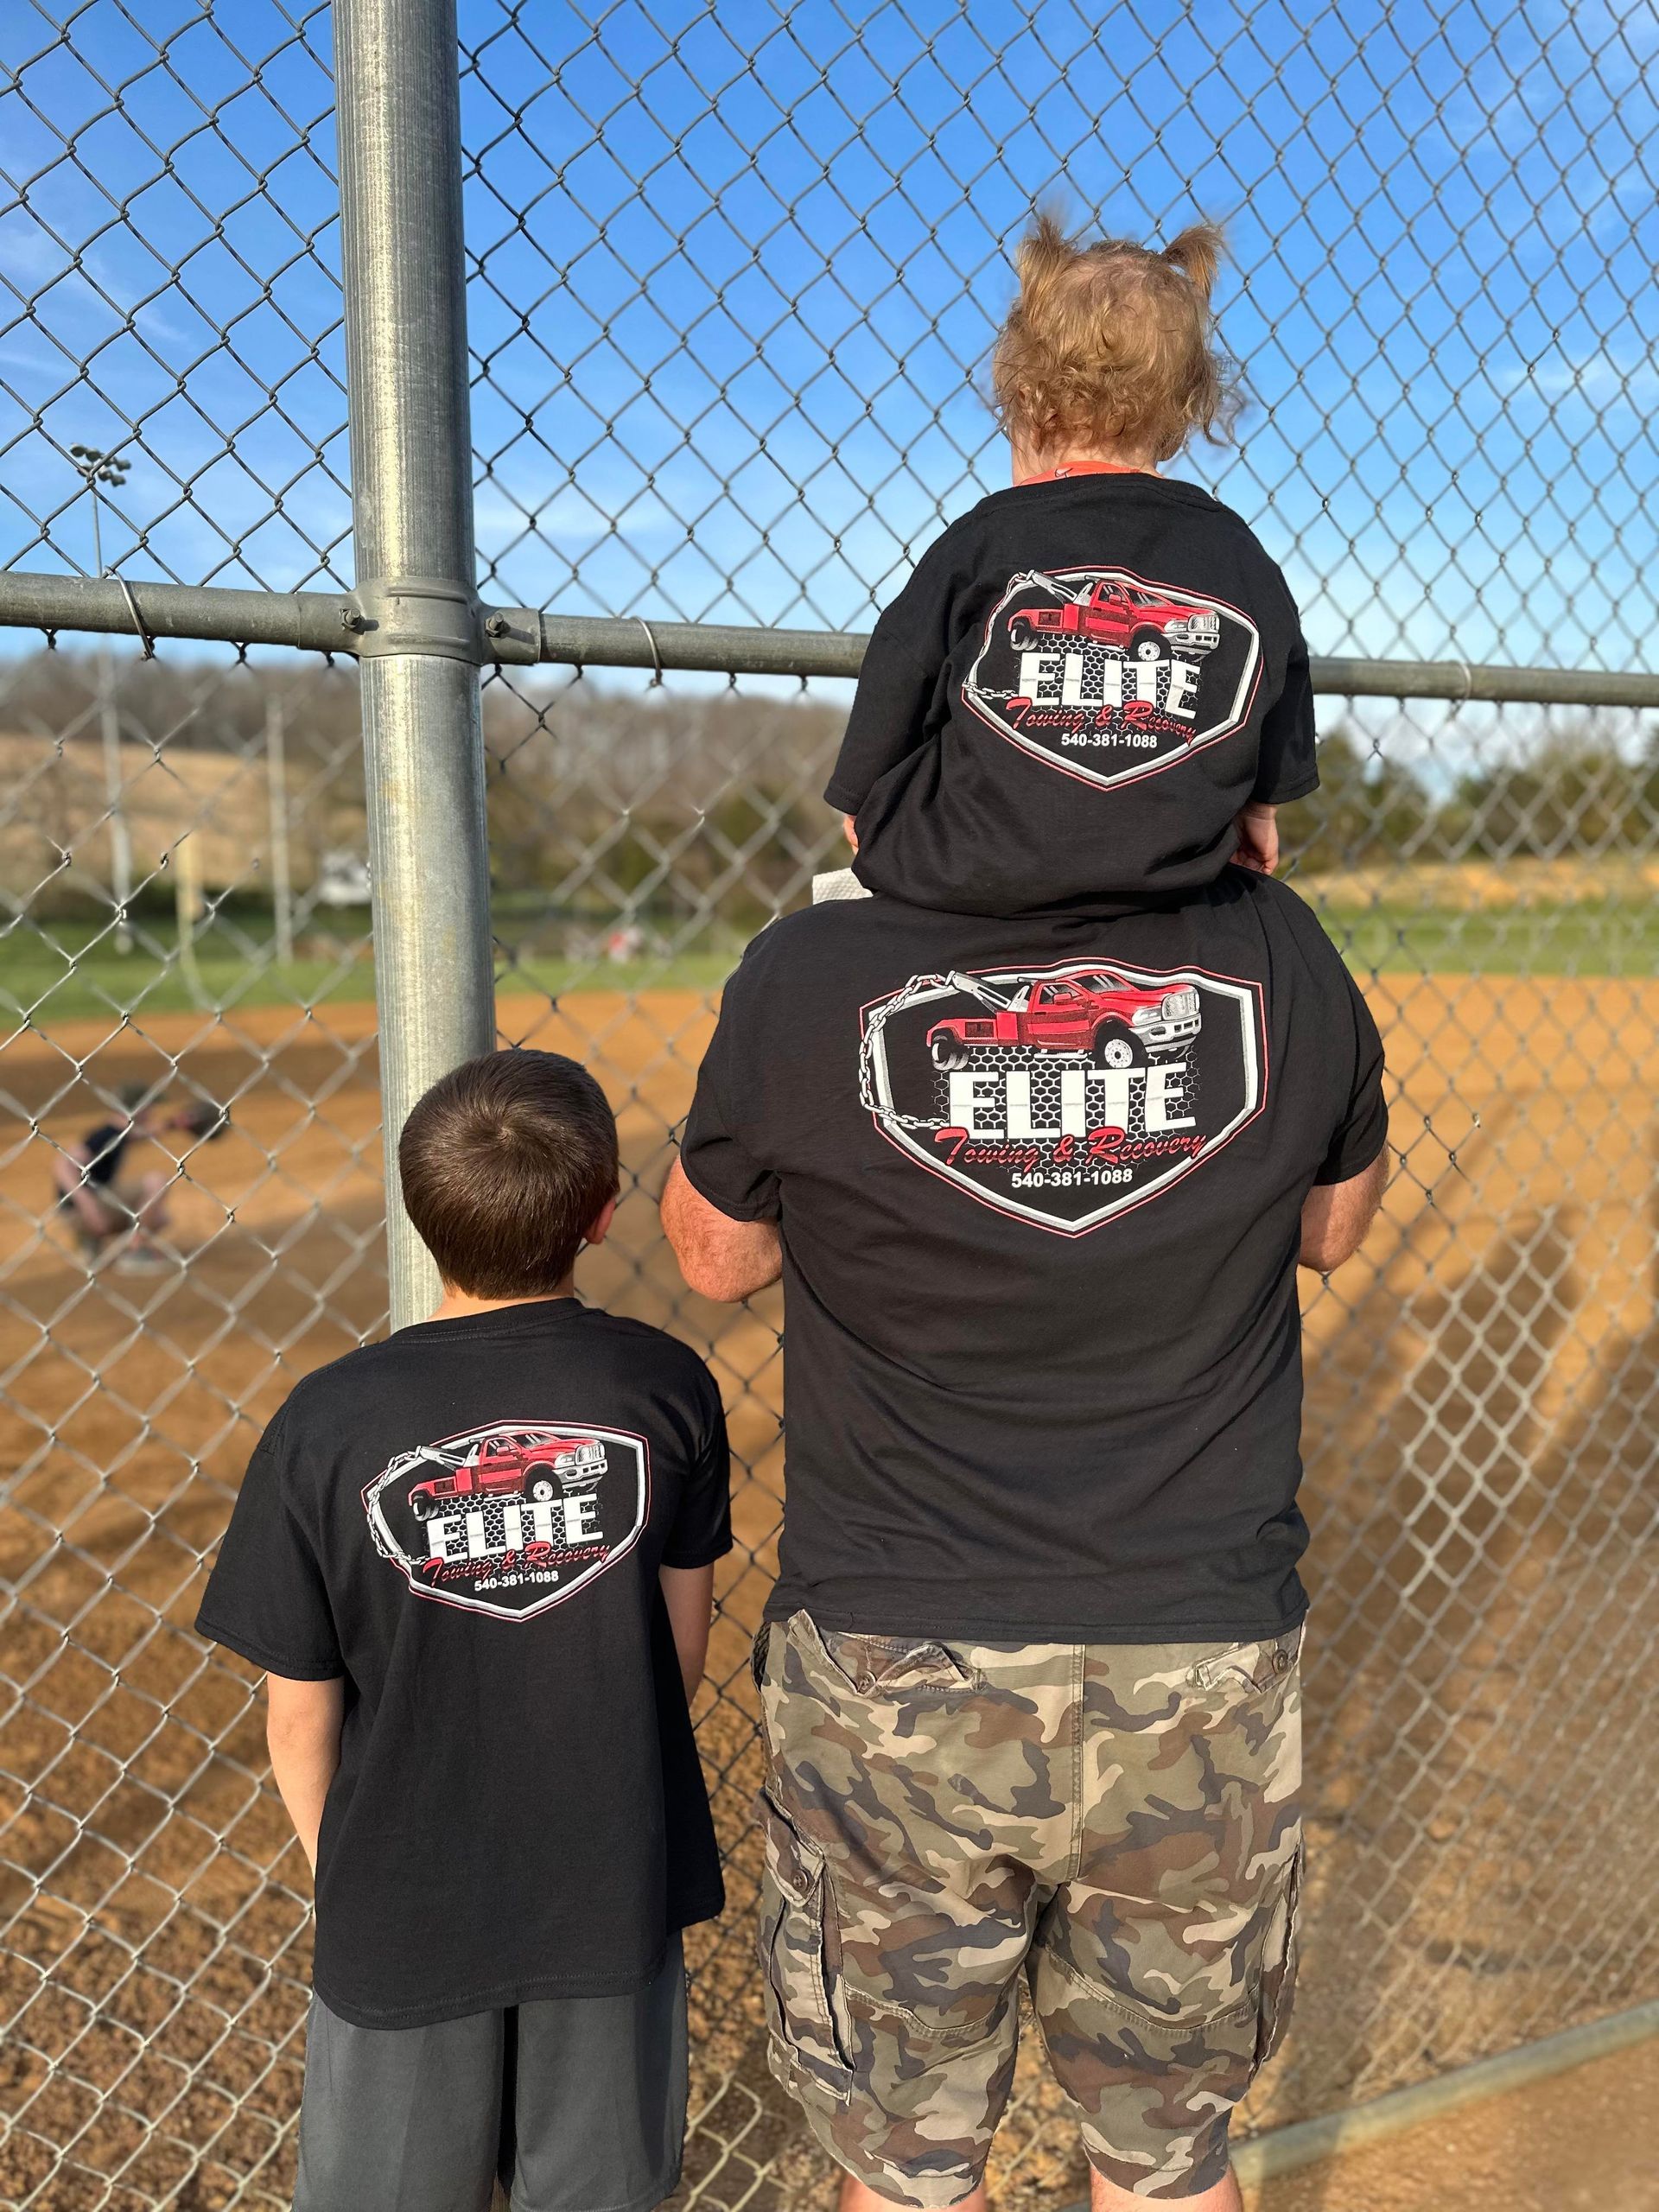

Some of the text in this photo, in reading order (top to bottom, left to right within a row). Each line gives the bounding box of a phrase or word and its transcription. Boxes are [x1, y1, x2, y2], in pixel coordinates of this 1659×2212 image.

[1019, 652, 1201, 719] ELITE
[1006, 696, 1198, 747] Towing & Recovery
[1061, 734, 1158, 747] 540-381-1088
[949, 1063, 1196, 1139] ELITE
[934, 1127, 1207, 1173] Towing & Recovery
[1011, 1168, 1133, 1188] 540-381-1088
[427, 1493, 603, 1564] ELITE
[423, 1541, 610, 1586] Towing & Recovery
[474, 1571, 558, 1592] 540-381-1088
